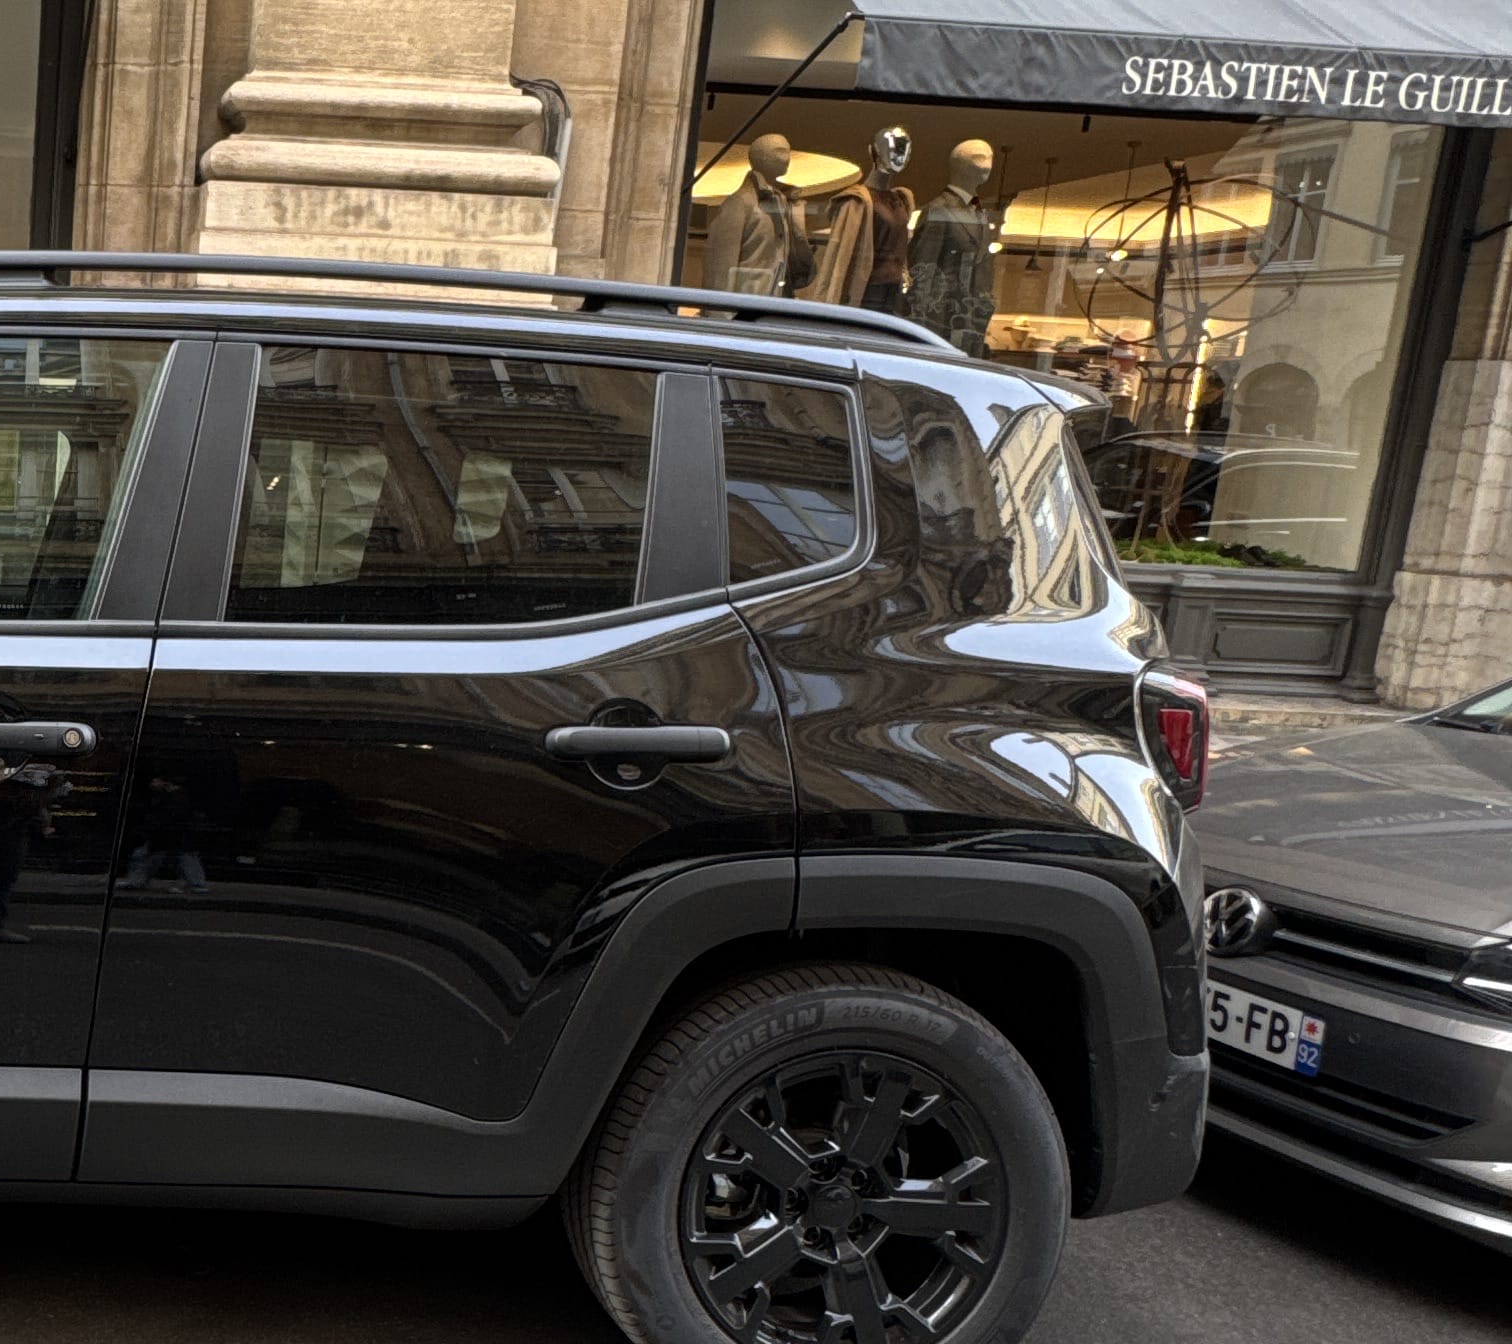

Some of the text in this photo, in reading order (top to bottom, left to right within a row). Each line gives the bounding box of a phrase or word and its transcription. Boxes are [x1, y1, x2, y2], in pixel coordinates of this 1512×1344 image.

[1121, 55, 1335, 106] SEBASTIEN
[1340, 68, 1390, 109] LE
[842, 1005, 903, 1022] 215/60
[1207, 987, 1290, 1055] 5-FB
[688, 1006, 818, 1094] MICHELIN
[1297, 1043, 1319, 1068] 92
